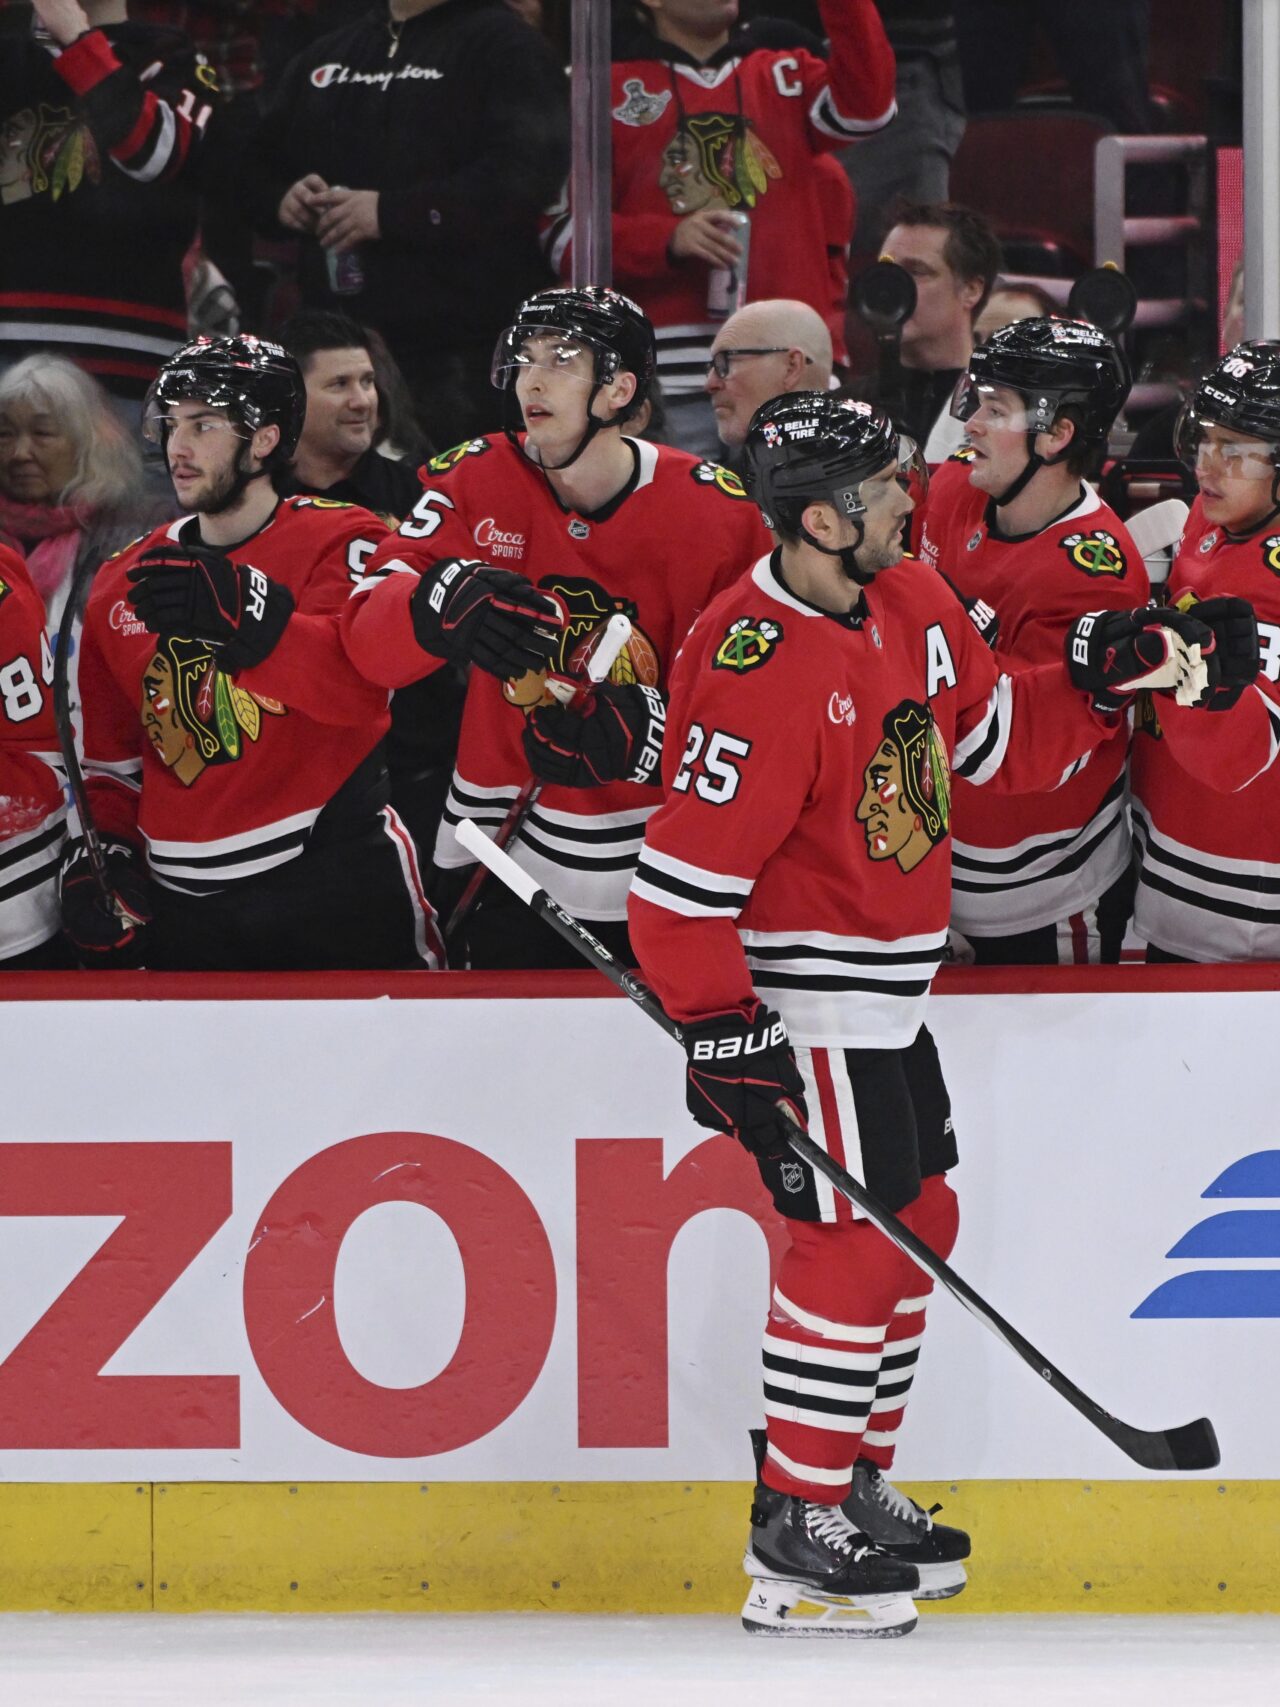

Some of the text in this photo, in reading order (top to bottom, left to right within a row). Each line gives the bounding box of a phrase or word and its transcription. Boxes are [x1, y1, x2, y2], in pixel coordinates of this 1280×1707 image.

[311, 63, 443, 91] Champion
[772, 57, 802, 97] C
[1204, 385, 1237, 406] CCM
[784, 418, 820, 432] BELLE
[789, 427, 816, 441] TIRE
[474, 518, 526, 547] Circa
[491, 544, 524, 560] SPORTS
[122, 623, 149, 637] SPORT
[926, 623, 957, 697] A
[672, 724, 750, 804] 25
[692, 1016, 788, 1060] BAUE
